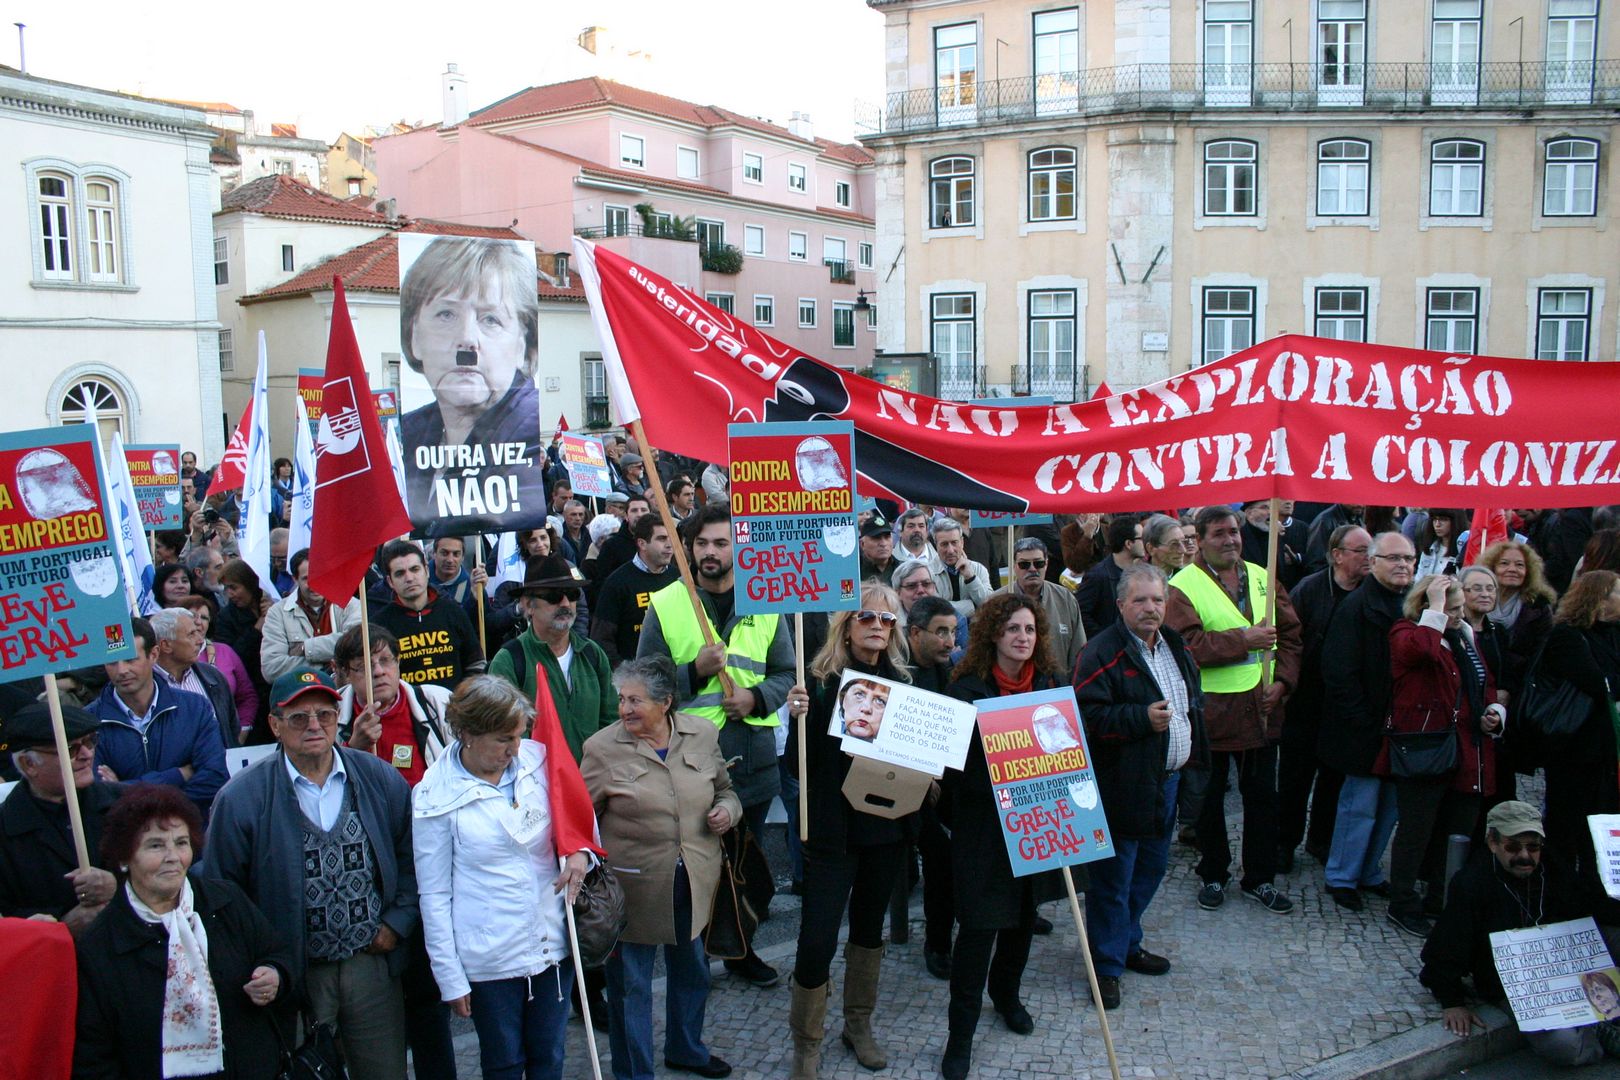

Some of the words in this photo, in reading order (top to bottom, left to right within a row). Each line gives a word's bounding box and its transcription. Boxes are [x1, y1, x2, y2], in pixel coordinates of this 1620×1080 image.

[628, 266, 781, 380] austeridad
[1105, 351, 1512, 430] EXPLORAÇÃO
[415, 444, 486, 470] OUTRA
[490, 442, 533, 468] VEZ,
[1035, 427, 1294, 494] CONTRA
[1311, 432, 1352, 480] A
[1371, 434, 1620, 487] COLONIZ
[731, 460, 791, 482] CONTRA
[435, 467, 521, 518] NÃO!
[732, 493, 743, 514] O
[750, 489, 851, 514] DESEMPREGO
[0, 512, 104, 552] EMPREGO
[735, 522, 749, 534] 14
[751, 521, 772, 531] POR
[776, 520, 794, 531] UM
[798, 516, 854, 529] PORTUGAL
[737, 534, 750, 543] NOV
[751, 531, 775, 543] COM
[780, 529, 823, 541] FUTURO
[31, 545, 113, 571] PORTUGAL
[737, 541, 823, 575] GREVE
[7, 566, 71, 589] FUTURO
[746, 569, 829, 603] GERAL
[0, 582, 76, 630] EVE
[399, 631, 450, 652] ENVC
[401, 665, 453, 683] MORTE
[898, 703, 918, 715] FAÇA
[921, 709, 931, 718] NA
[932, 712, 953, 724] CAMA
[906, 695, 926, 707] FRAU
[927, 701, 955, 716] MERKEL
[893, 712, 922, 726] AQUILO
[924, 719, 940, 730] QUE
[942, 724, 958, 736] NOS
[893, 722, 915, 734] ANDA
[924, 730, 947, 743] FAZER
[889, 730, 915, 744] TODOS
[917, 737, 929, 748] OS
[983, 728, 1034, 754] CONTRA
[990, 763, 1001, 783] O
[1003, 748, 1086, 781] DESEMPREGO
[997, 788, 1010, 801] 14
[1010, 785, 1028, 797] POR
[1029, 782, 1046, 794] UM
[1046, 772, 1092, 791] PORTUGAL
[1012, 796, 1033, 807] COM
[1033, 787, 1069, 802] FUTURO
[1005, 798, 1075, 835] GREVE
[1018, 823, 1086, 861] GERAL
